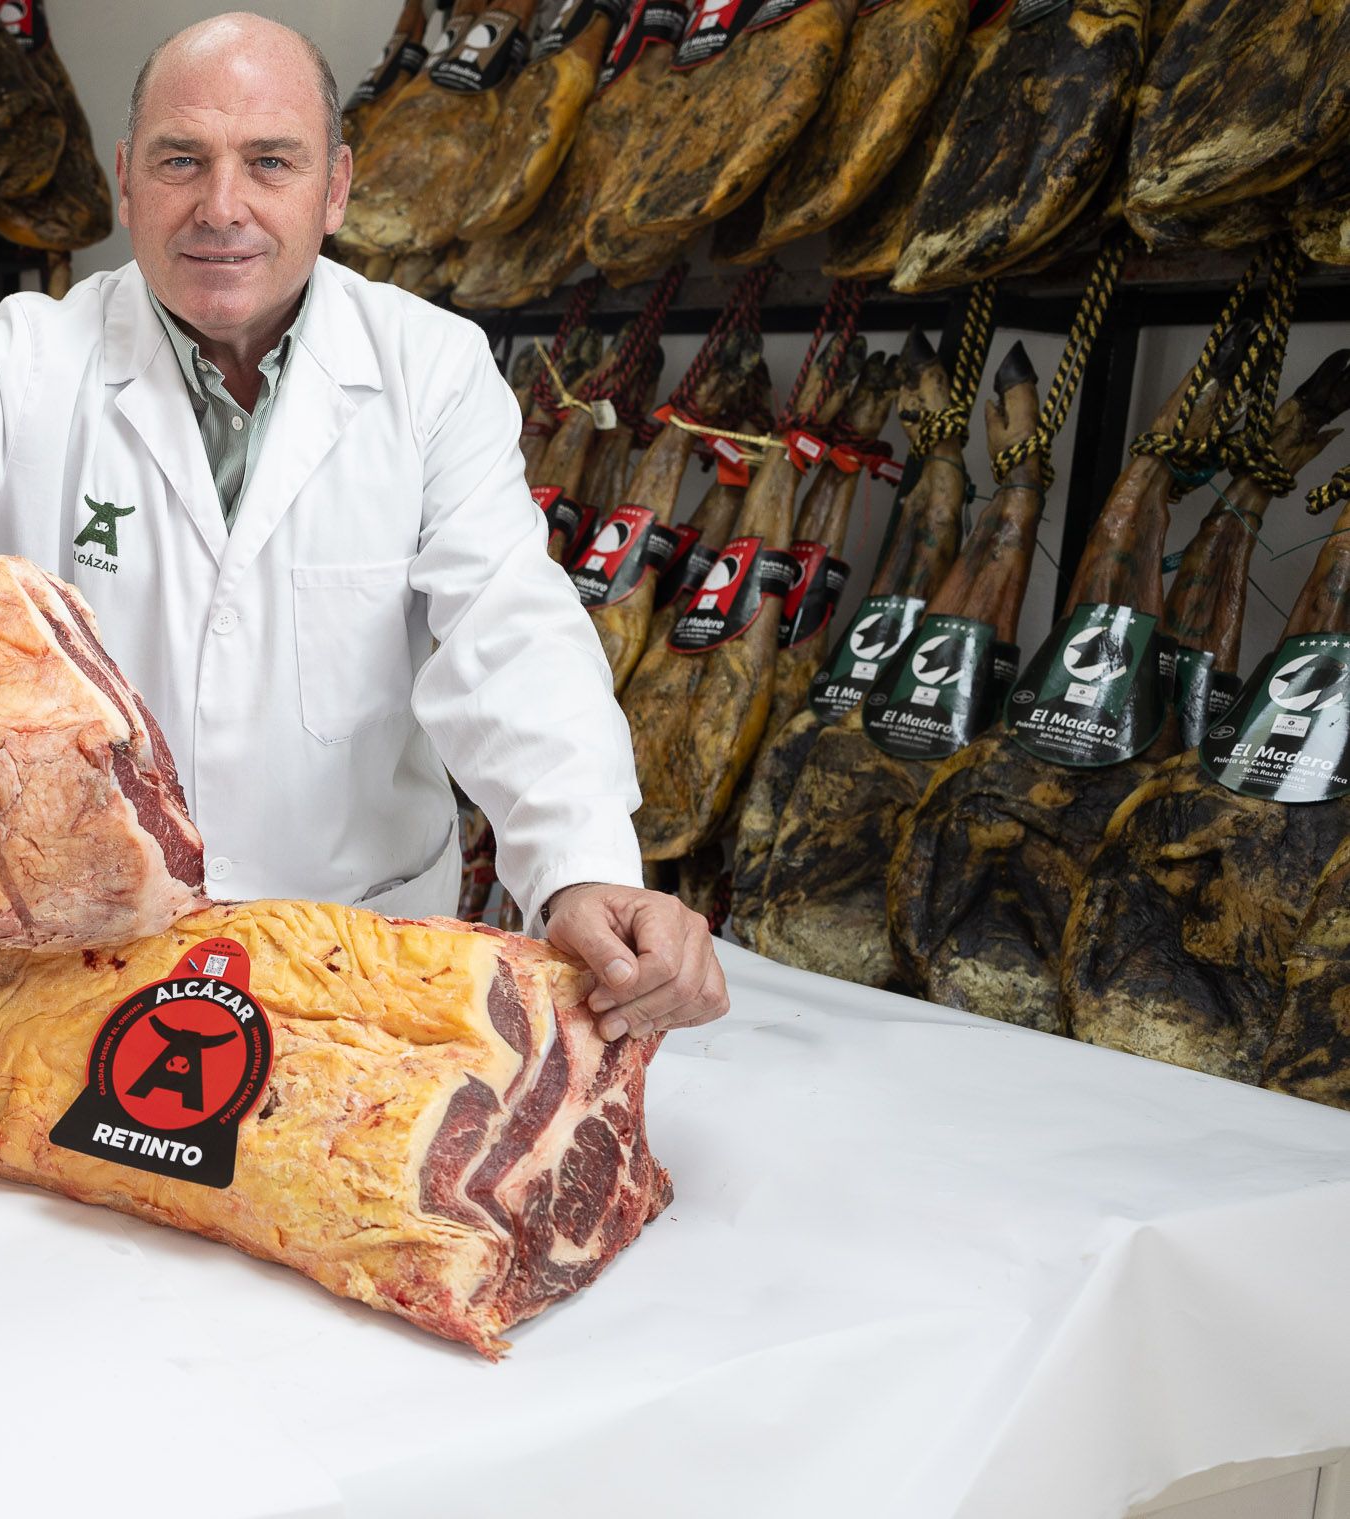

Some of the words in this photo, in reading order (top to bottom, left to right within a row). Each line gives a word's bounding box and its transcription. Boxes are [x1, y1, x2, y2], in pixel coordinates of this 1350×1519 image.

[825, 685, 839, 697] El
[882, 710, 898, 722] El
[898, 712, 952, 734] Madero
[1030, 709, 1049, 722] El
[1050, 712, 1117, 738] Madero
[1213, 756, 1237, 764] Paleta
[1239, 757, 1249, 765] de
[1251, 760, 1271, 768] Cebo
[1273, 762, 1284, 771] de
[1285, 765, 1316, 777] Campo
[1316, 770, 1348, 784] Ibérica
[1231, 743, 1252, 757] El
[1254, 745, 1334, 771] Madero
[1260, 769, 1279, 778] Raza
[1280, 772, 1307, 783] Ibérica
[118, 1002, 144, 1025] ORIGEN
[155, 979, 255, 1024] ALCÁZAR
[111, 1027, 120, 1036] EL
[100, 1035, 114, 1060] DESDE
[251, 1026, 262, 1080] INDUSTRIAS
[98, 1062, 106, 1096] CALIDAD
[92, 1122, 203, 1167] RETINTO
